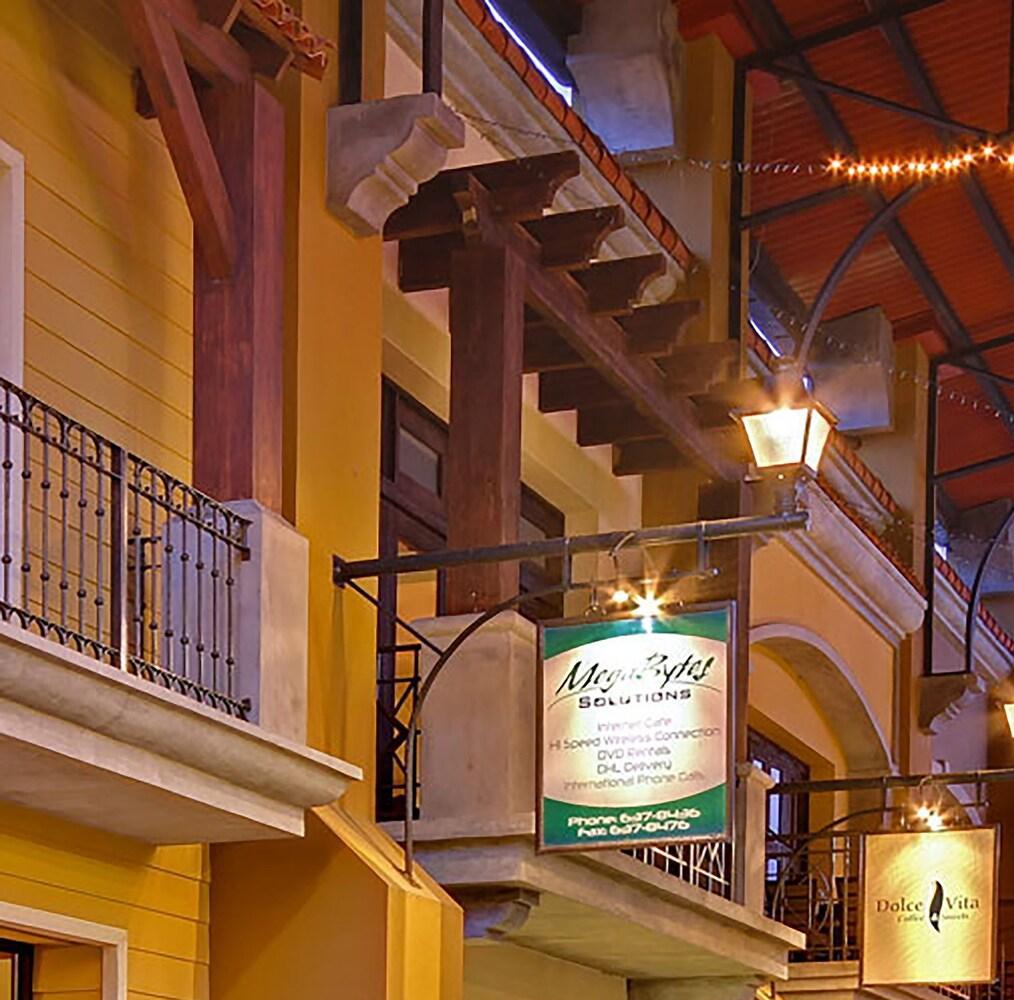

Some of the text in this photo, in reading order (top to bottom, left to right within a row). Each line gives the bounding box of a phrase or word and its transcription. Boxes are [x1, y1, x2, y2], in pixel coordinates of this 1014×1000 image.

[578, 689, 692, 709] SOLUTIONS
[597, 748, 624, 761] DVD
[877, 894, 980, 913] Dolce Vita
